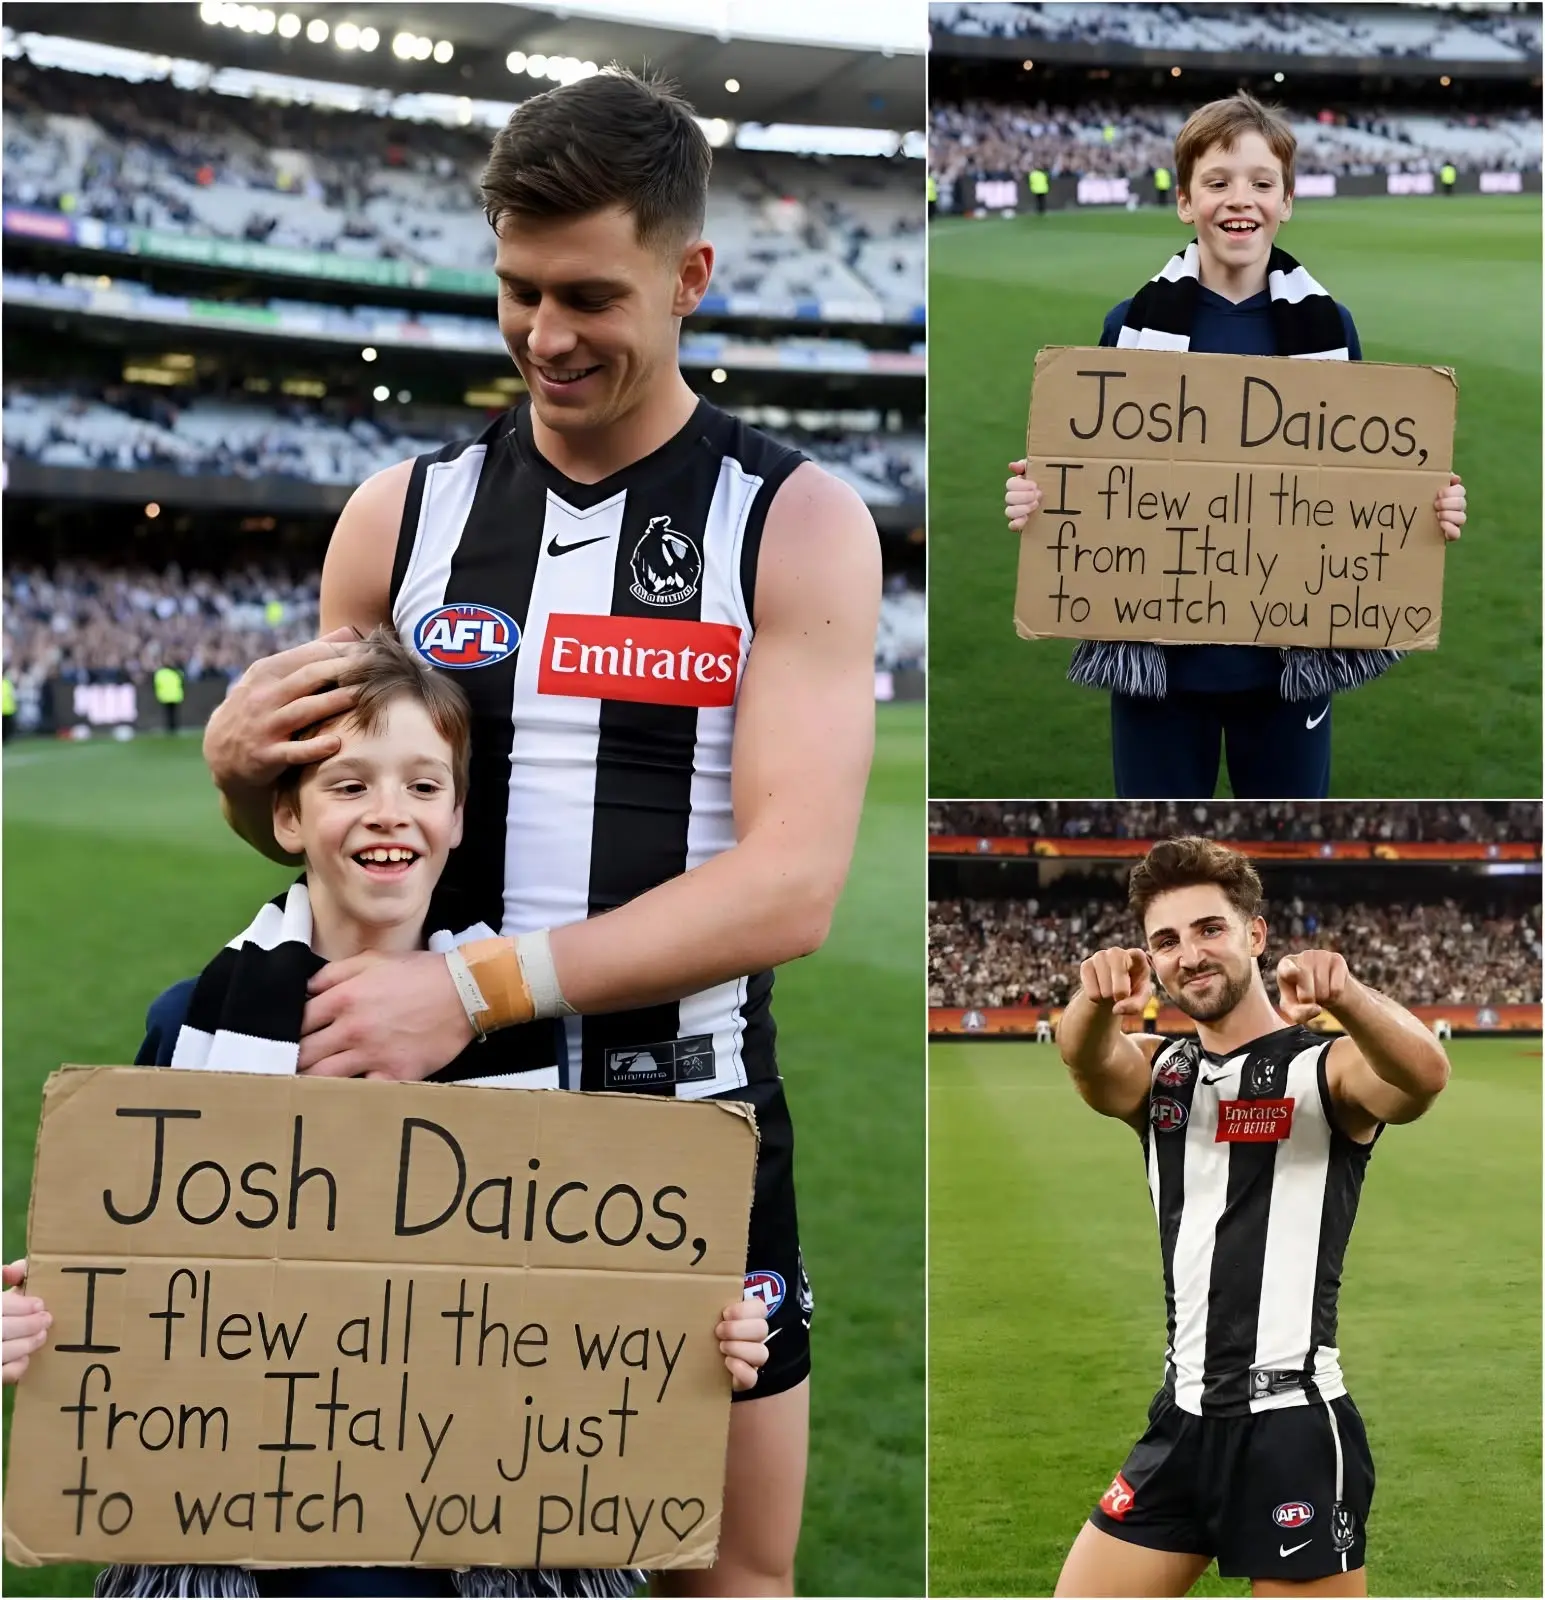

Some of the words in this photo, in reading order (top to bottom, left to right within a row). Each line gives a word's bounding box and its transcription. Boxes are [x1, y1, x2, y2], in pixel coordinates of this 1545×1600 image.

[1070, 371, 1206, 443] Josh
[1241, 377, 1428, 466] Daicos,
[1043, 463, 1084, 516] I
[1098, 465, 1190, 520] flew
[1208, 473, 1253, 524] all
[1270, 473, 1334, 527] the
[1350, 500, 1418, 549] way
[1047, 521, 1145, 574] from
[1163, 525, 1278, 595] Italy
[1305, 532, 1390, 595] just
[419, 619, 509, 652] AFL
[1049, 575, 1091, 623] to
[1115, 578, 1226, 625] watch
[1250, 600, 1308, 642] you
[1330, 585, 1401, 647] play
[551, 636, 734, 684] Emirates
[1150, 1103, 1181, 1124] AFL
[1225, 1106, 1288, 1121] Emirates
[103, 1107, 337, 1231] Josh
[395, 1117, 707, 1266] Daicos,
[55, 1267, 127, 1354] I
[149, 1268, 308, 1361] flew
[337, 1279, 414, 1364] all
[441, 1279, 548, 1368] the
[575, 1324, 687, 1403] way
[60, 1364, 229, 1451] from
[258, 1367, 454, 1483] Italy
[497, 1376, 639, 1482] just
[62, 1456, 134, 1536] to
[175, 1456, 364, 1535] watch
[405, 1493, 502, 1562] you
[535, 1464, 655, 1567] play
[1277, 1506, 1311, 1523] AFL
